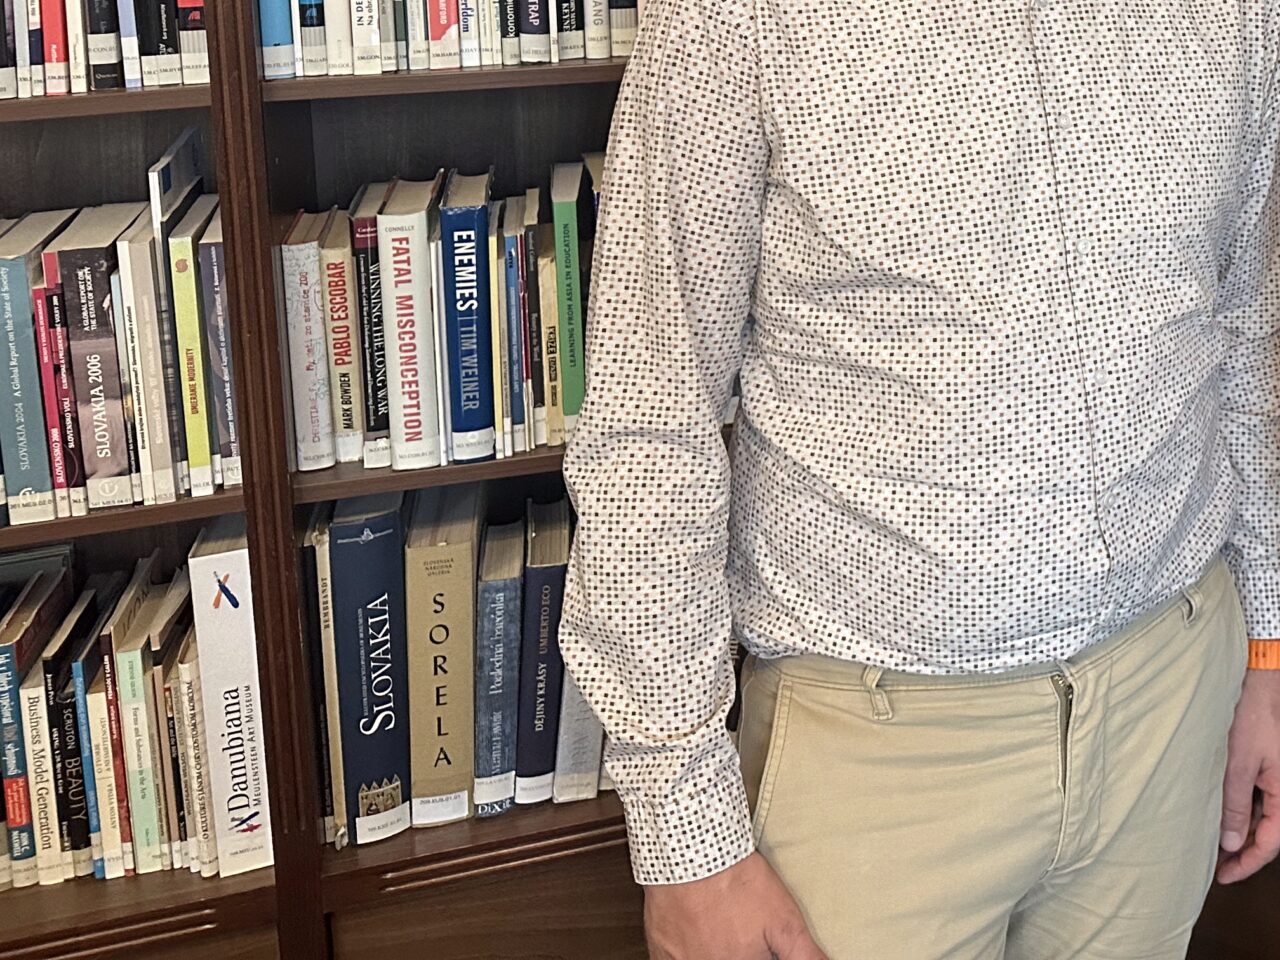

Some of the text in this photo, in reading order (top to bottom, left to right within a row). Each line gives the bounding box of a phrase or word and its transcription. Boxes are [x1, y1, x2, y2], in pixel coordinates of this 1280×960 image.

[327, 261, 354, 429] MARK BOWDEN PABLO ESCOBAR
[392, 236, 422, 443] FATAL MISCONCEPTION
[454, 231, 479, 408] ENEMIES TIM WEINER
[86, 354, 111, 457] SLOVAKIA 2006
[321, 576, 329, 630] REMBRANDT
[360, 593, 396, 736] SLOVAKIA
[62, 708, 75, 748] SCRUTON
[244, 684, 262, 806] MEULENSTEEN ART MUSEUM
[429, 593, 452, 768] SORELA
[27, 695, 52, 850] Business Model Generation
[66, 758, 87, 820] BEAUTY
[221, 687, 250, 811] Danubiana
